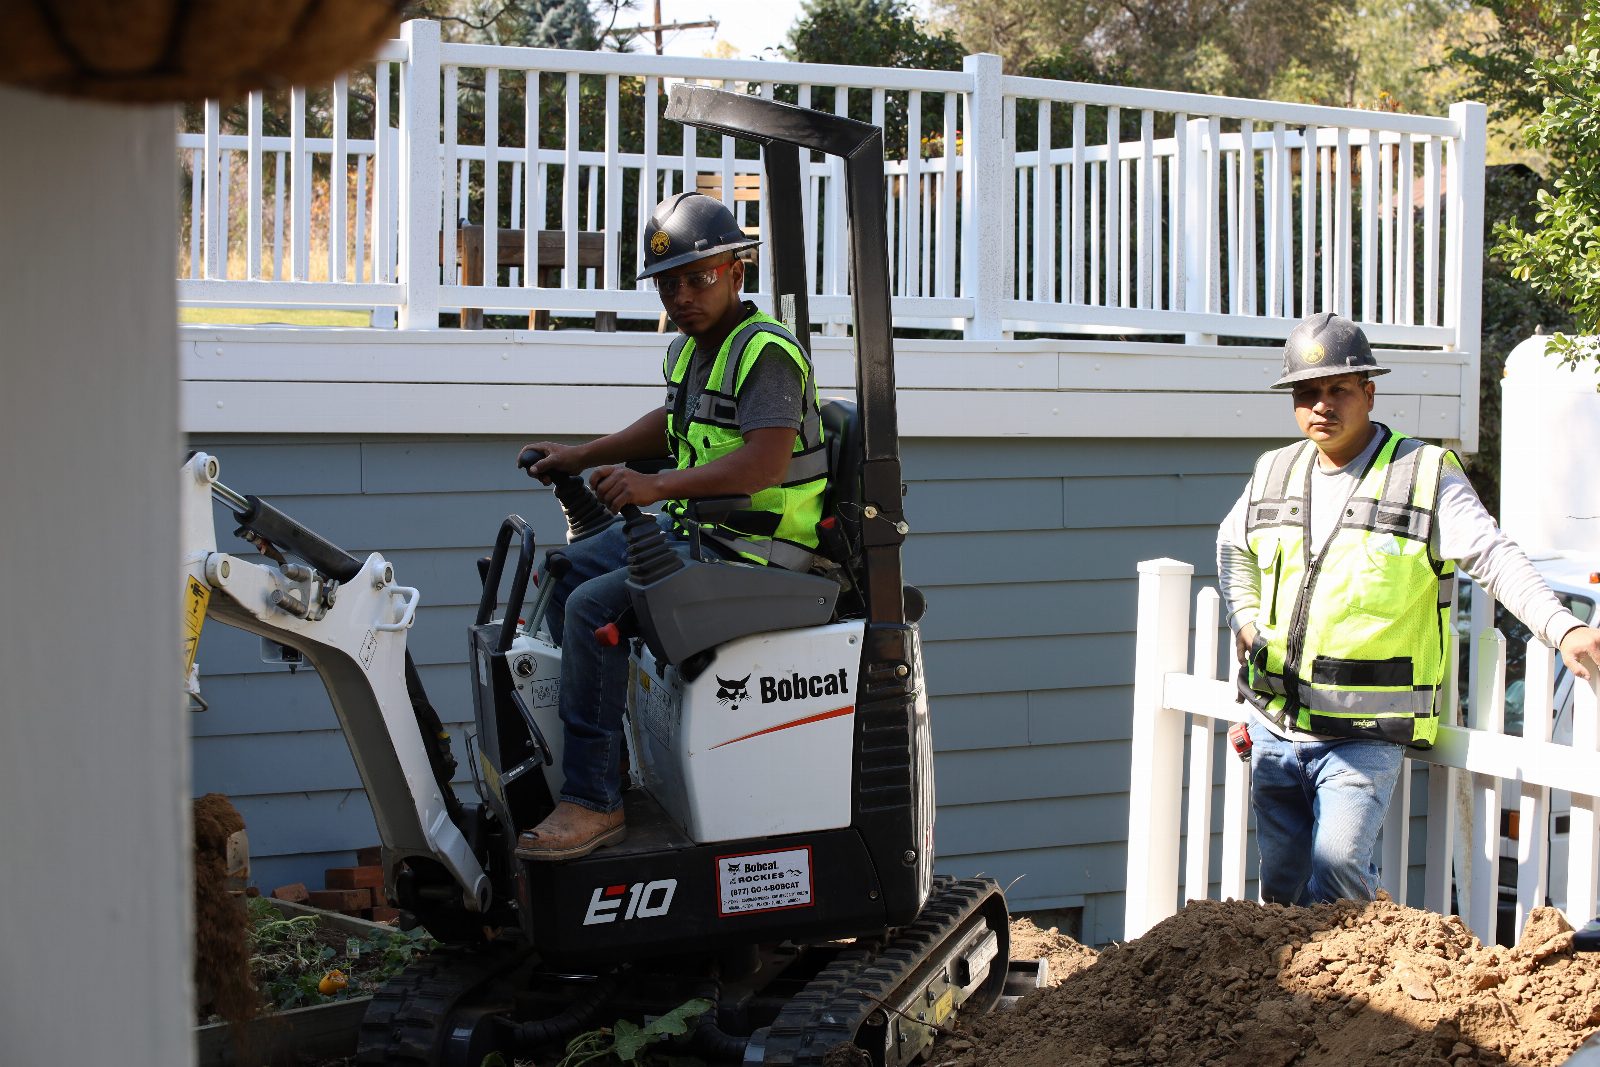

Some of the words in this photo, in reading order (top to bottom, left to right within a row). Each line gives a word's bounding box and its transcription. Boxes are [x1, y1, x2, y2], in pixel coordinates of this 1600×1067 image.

[760, 668, 849, 704] Bobcat
[744, 861, 778, 873] Bobcat
[738, 872, 785, 883] ROCKIES
[731, 887, 749, 897] (877)
[583, 878, 677, 925] E10
